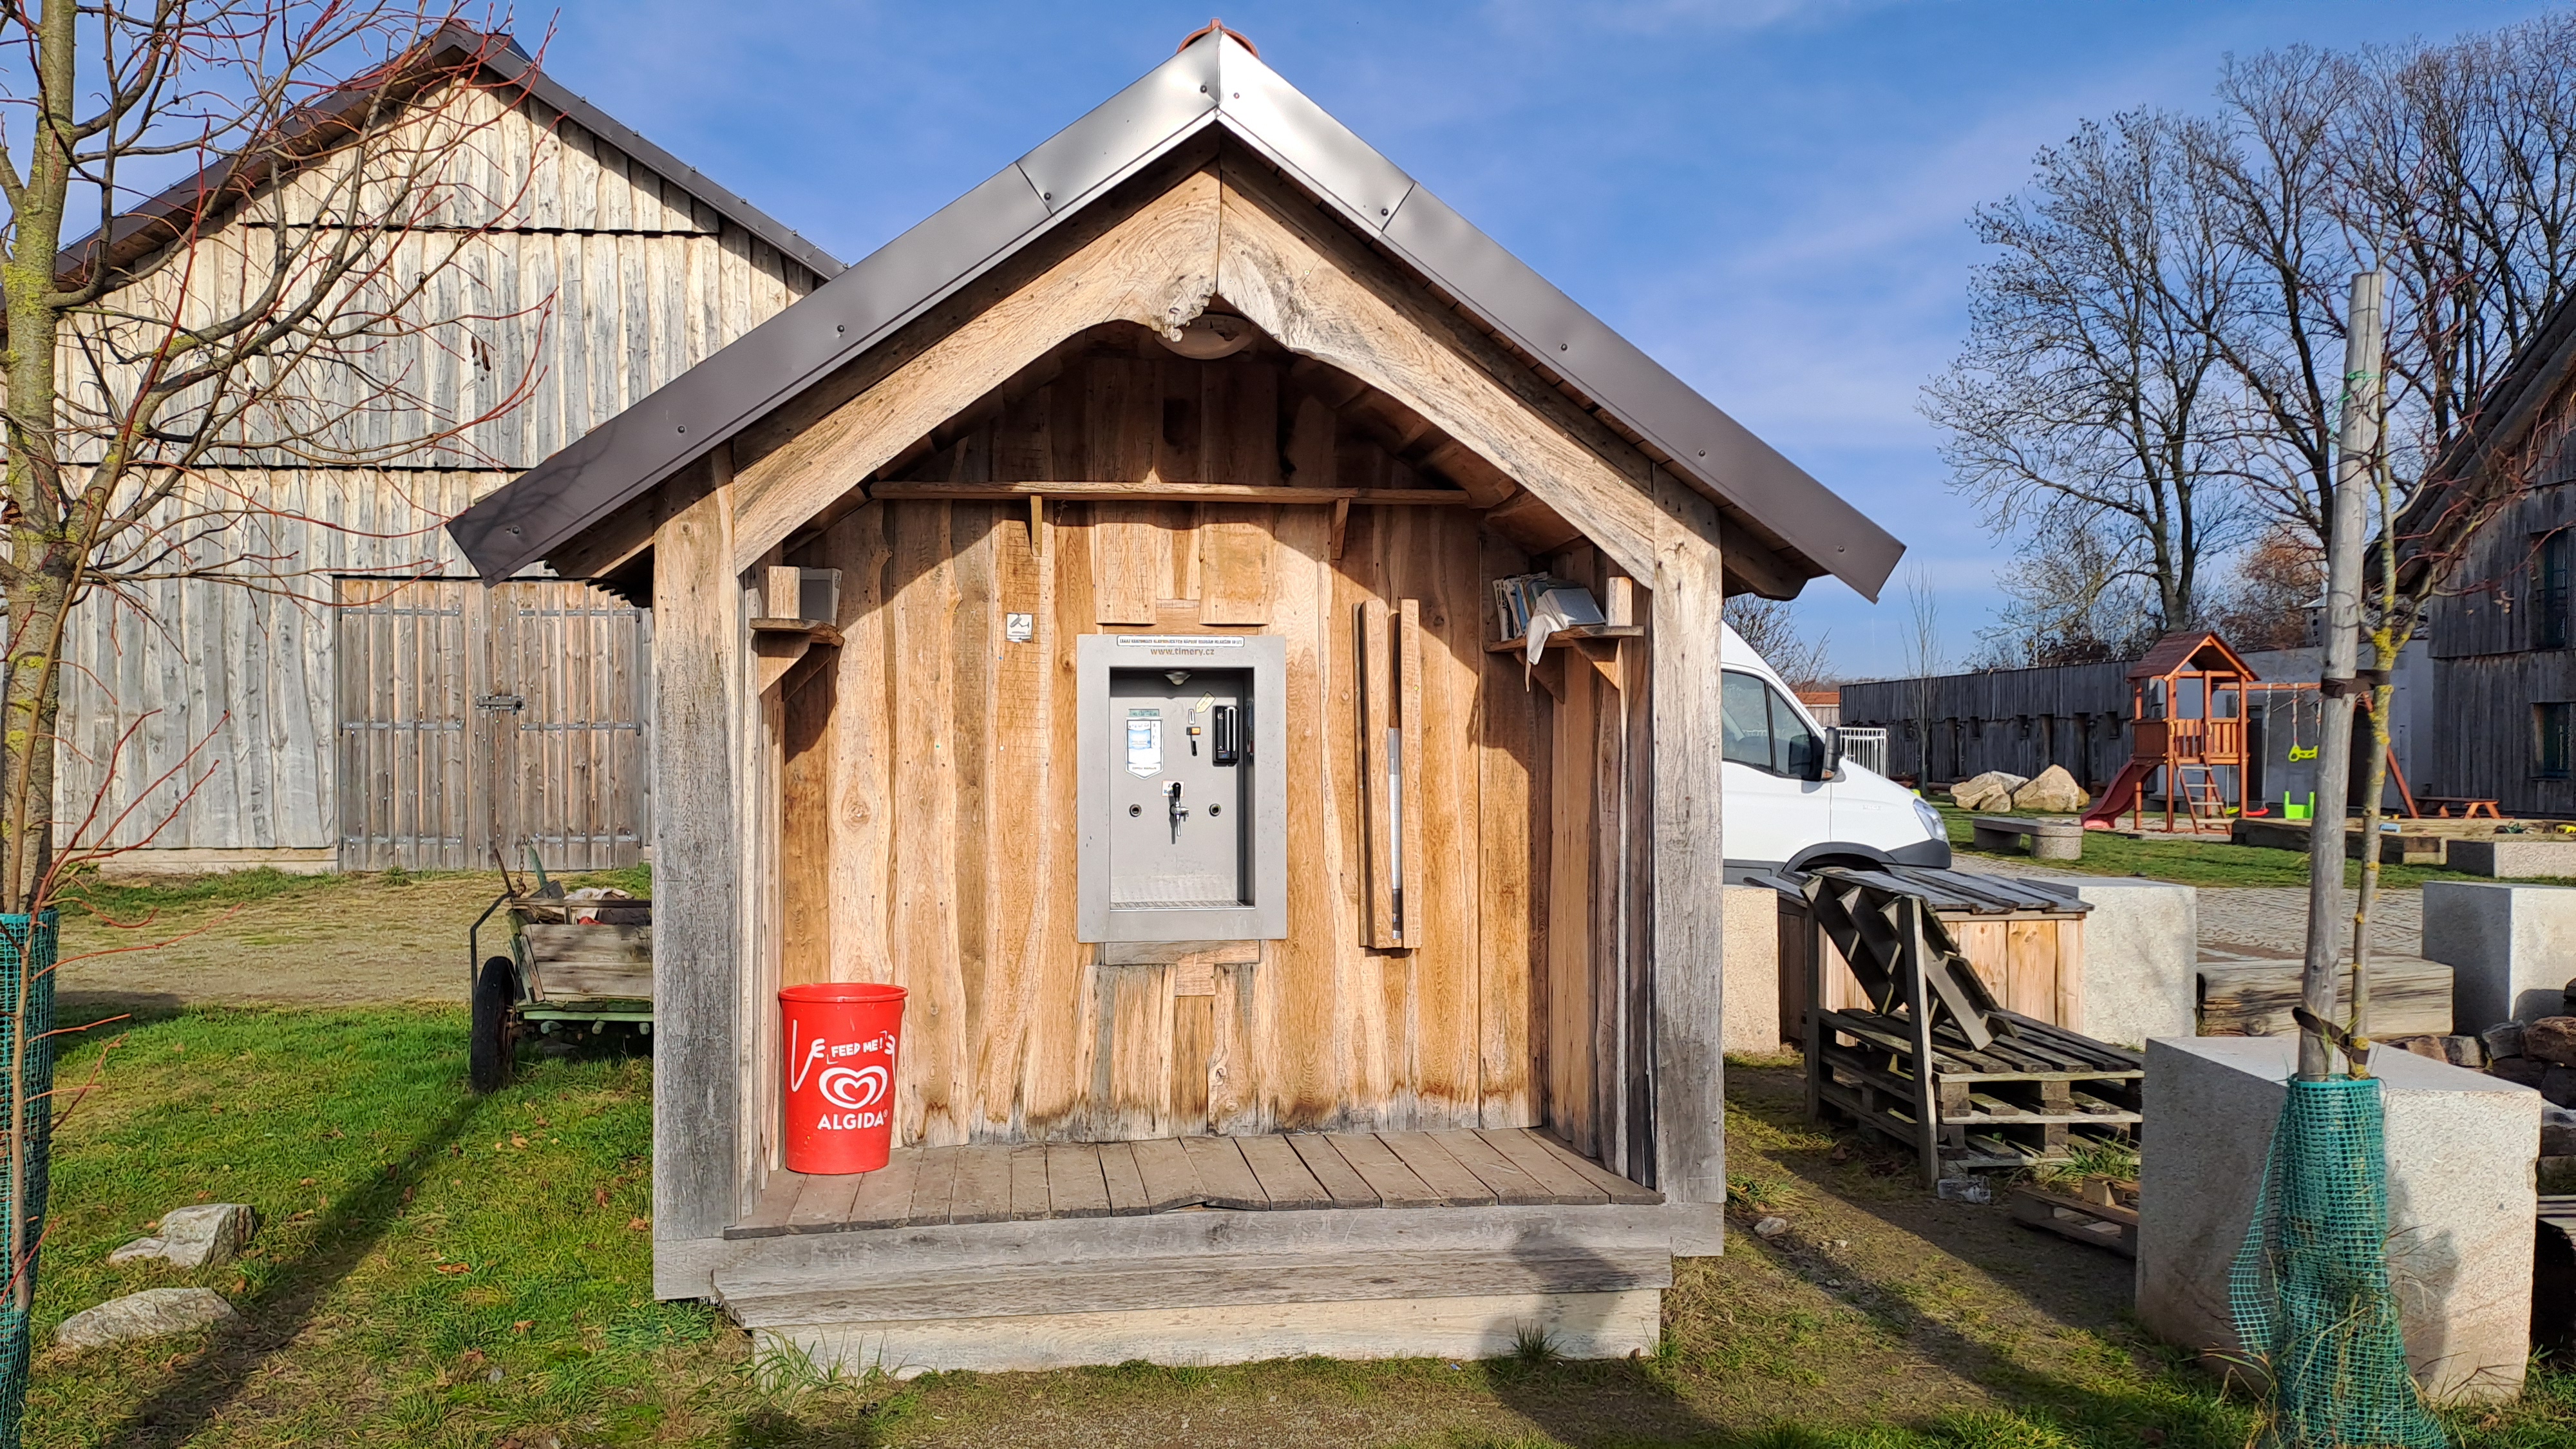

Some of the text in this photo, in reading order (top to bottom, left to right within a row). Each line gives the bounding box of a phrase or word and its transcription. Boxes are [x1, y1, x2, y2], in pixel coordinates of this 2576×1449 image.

[1150, 647, 1215, 656] www.timery.cz
[831, 1037, 884, 1058] FEED ME!
[817, 1110, 884, 1130] ALGIDA
